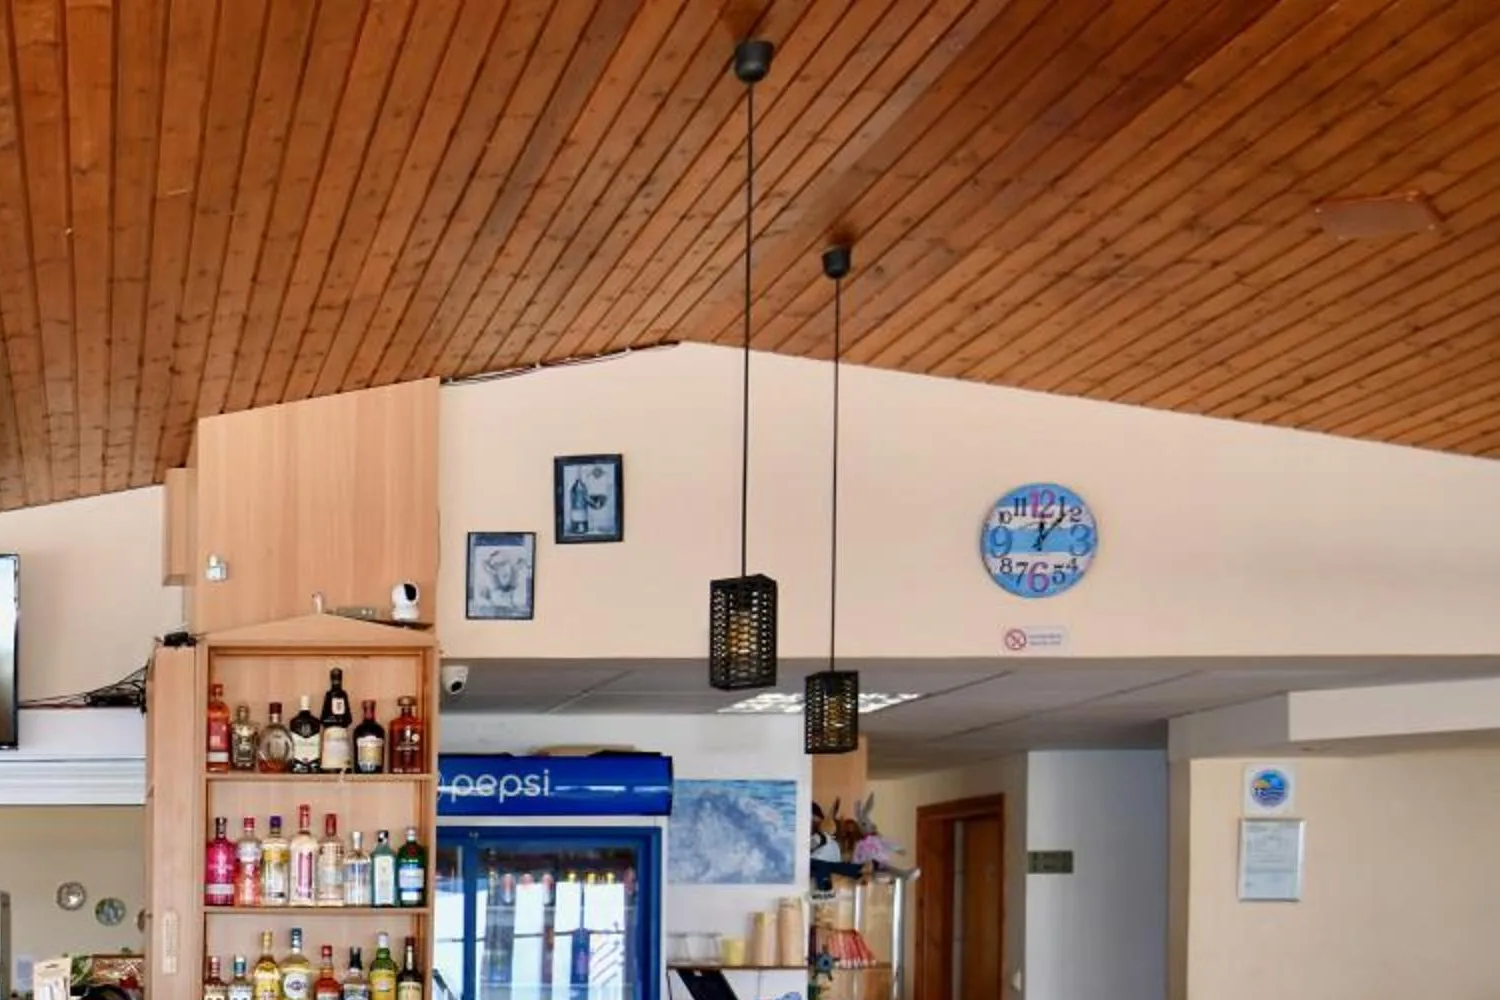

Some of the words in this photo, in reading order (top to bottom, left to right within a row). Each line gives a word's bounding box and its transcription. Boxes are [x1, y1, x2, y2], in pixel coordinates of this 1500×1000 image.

[1013, 497, 1027, 517] 11
[1030, 488, 1056, 518] 12
[1058, 495, 1066, 517] 1
[1069, 507, 1082, 522] 2
[989, 525, 1012, 558] 9
[1068, 524, 1092, 556] 3
[999, 557, 1013, 575] 8
[1015, 562, 1029, 587] 7
[1027, 562, 1050, 593] 6
[1051, 564, 1066, 585] 5
[450, 768, 550, 804] pepsi
